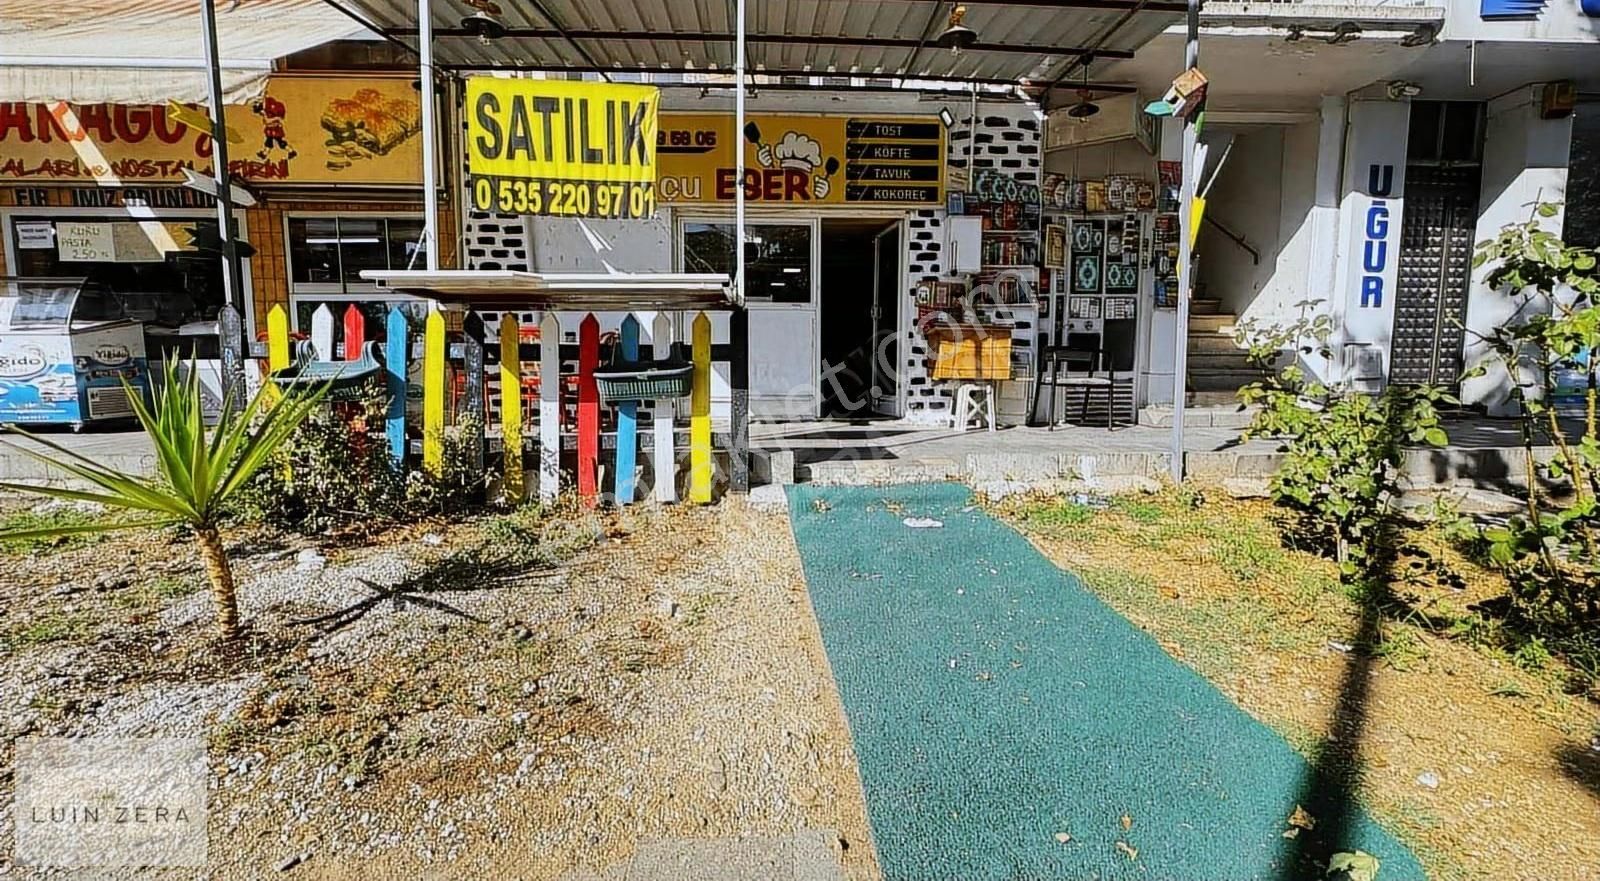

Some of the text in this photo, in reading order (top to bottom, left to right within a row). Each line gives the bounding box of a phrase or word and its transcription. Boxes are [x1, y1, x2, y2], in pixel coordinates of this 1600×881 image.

[476, 92, 651, 166] SATILIK
[875, 125, 903, 136] TOST
[874, 167, 912, 179] TAVUK
[475, 178, 655, 218] 0 535 220 97 01
[1359, 164, 1394, 308] UĞUR
